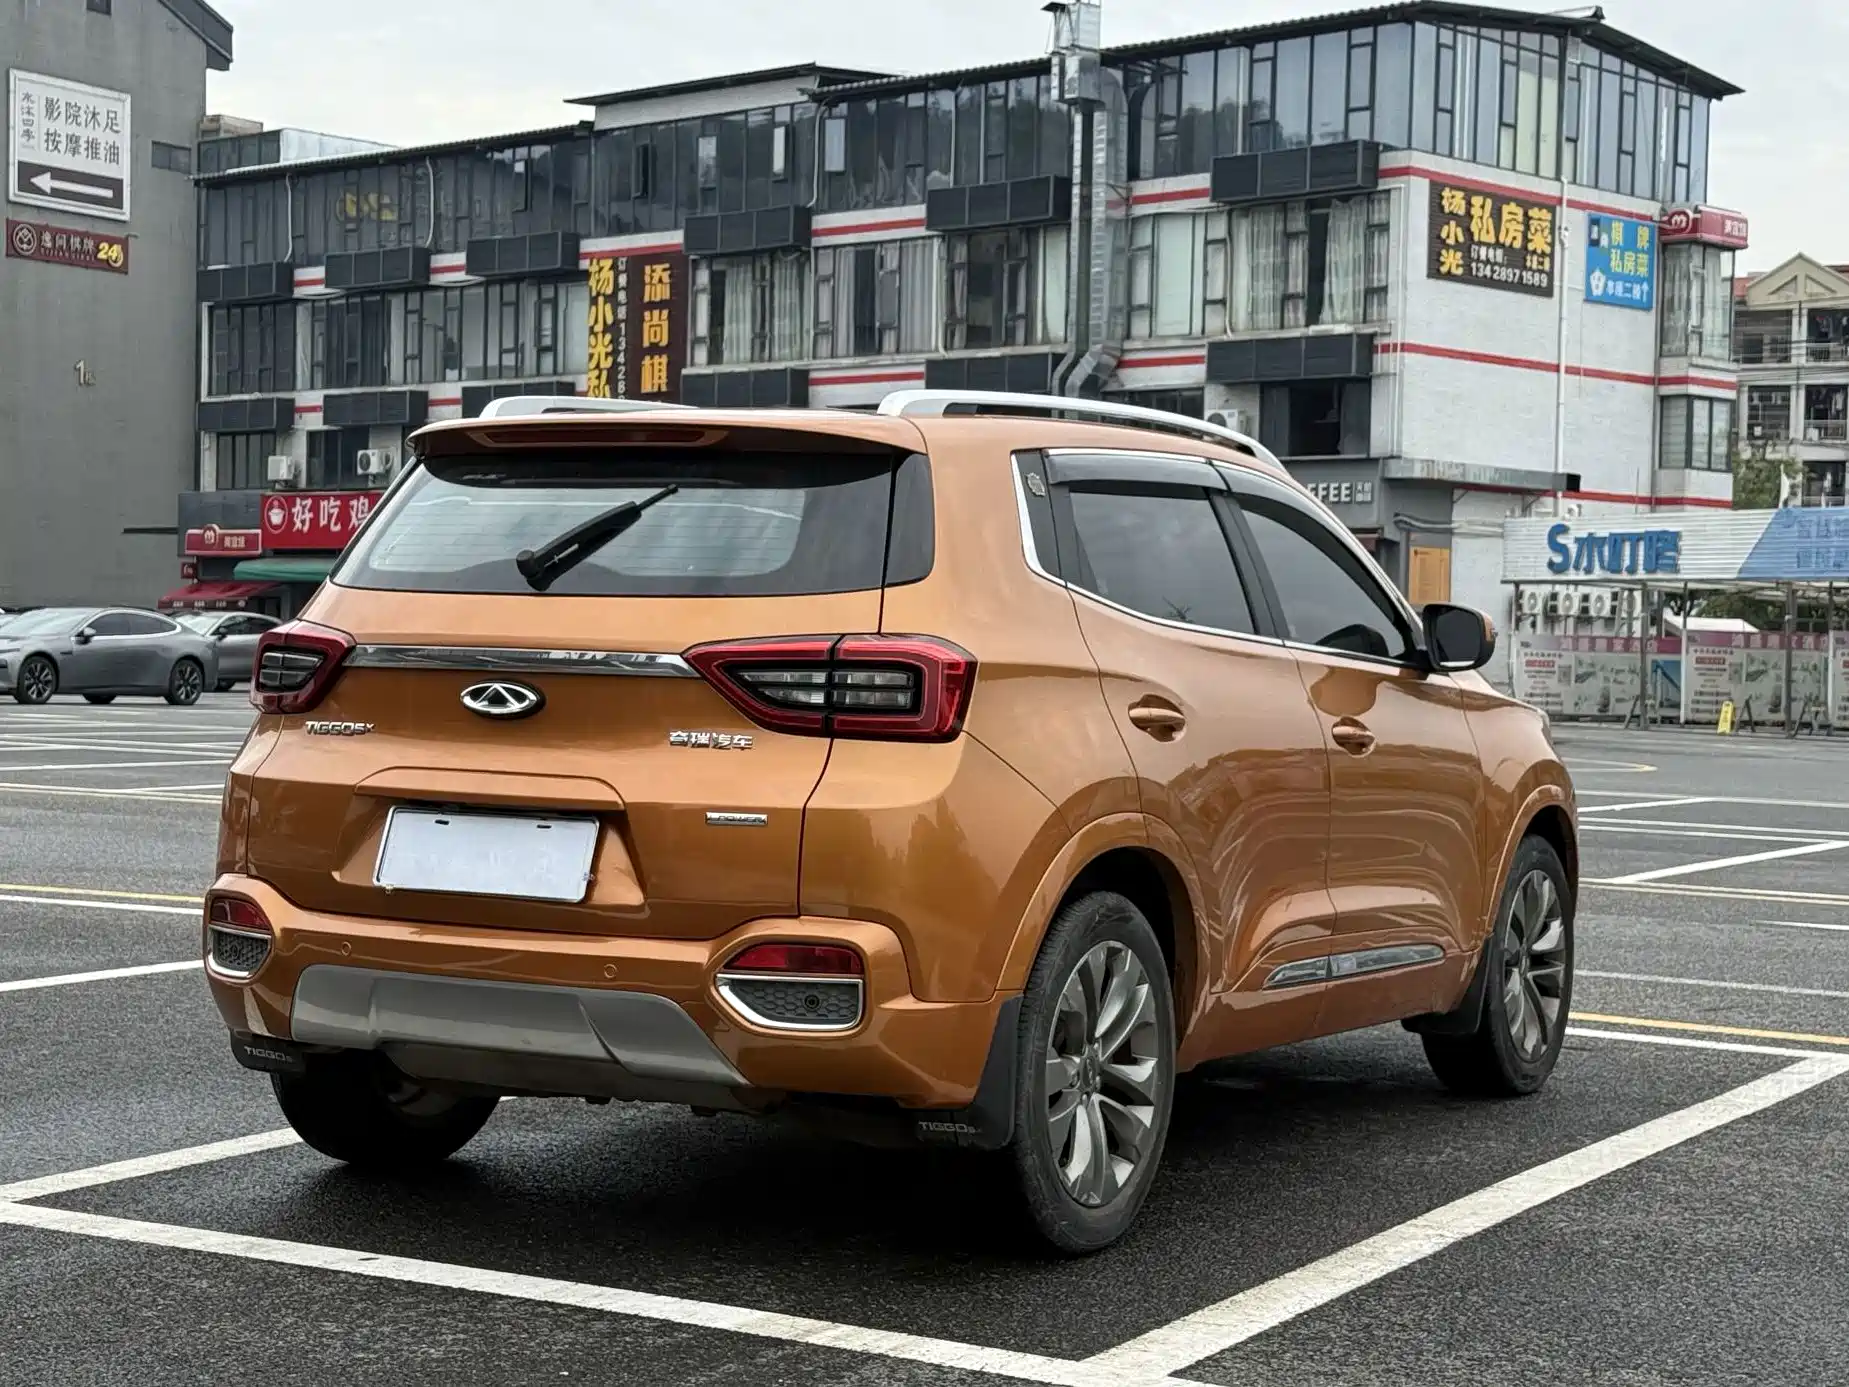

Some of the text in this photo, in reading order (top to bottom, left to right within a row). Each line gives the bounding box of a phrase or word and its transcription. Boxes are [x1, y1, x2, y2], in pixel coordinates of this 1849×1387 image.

[44, 96, 121, 134] 影院沐足
[44, 127, 120, 165] 按摩推油
[1440, 187, 1466, 276] 杨小光
[1470, 195, 1552, 255] 私房菜
[587, 258, 615, 398] 杨小光私
[292, 495, 371, 534] 好吃鸡
[669, 730, 754, 751] 奇瑞汽车
